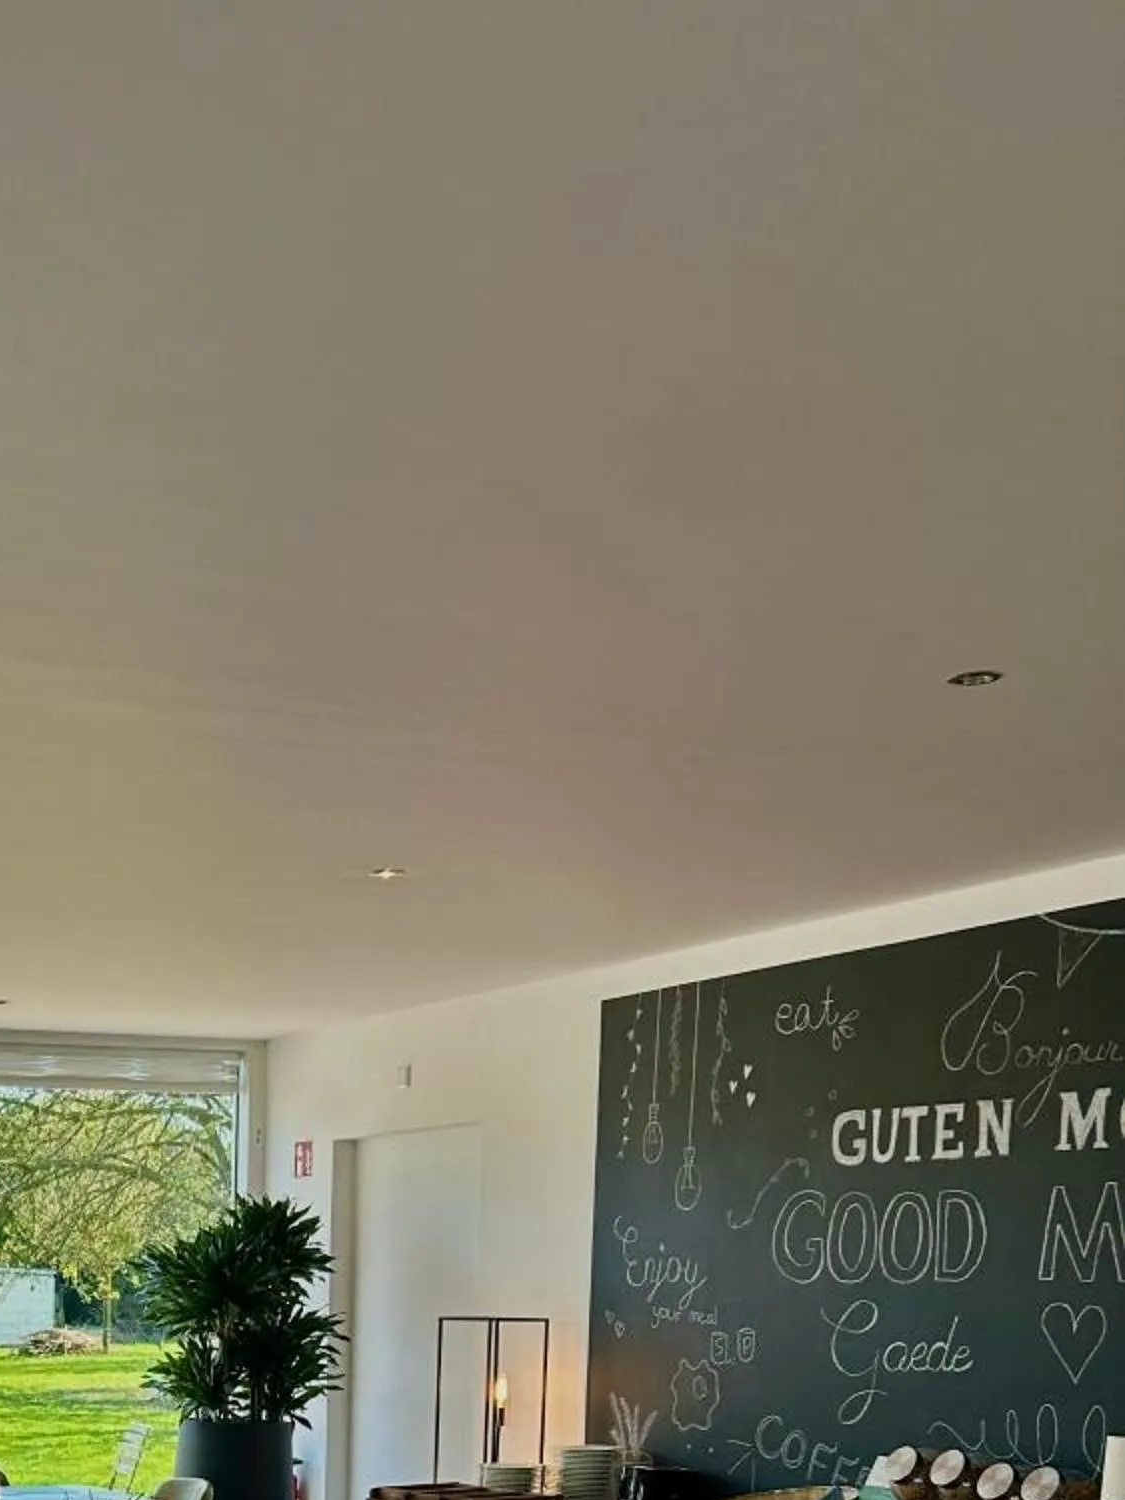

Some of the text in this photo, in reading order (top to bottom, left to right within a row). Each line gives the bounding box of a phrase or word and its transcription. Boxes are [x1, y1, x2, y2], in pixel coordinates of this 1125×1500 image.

[775, 984, 839, 1034] eat
[940, 950, 1123, 1128] Bonjour
[831, 1087, 1125, 1167] GUTEN M
[612, 1215, 708, 1310] Enjoy
[772, 1188, 988, 1284] GOOD
[650, 1303, 718, 1329] your meal
